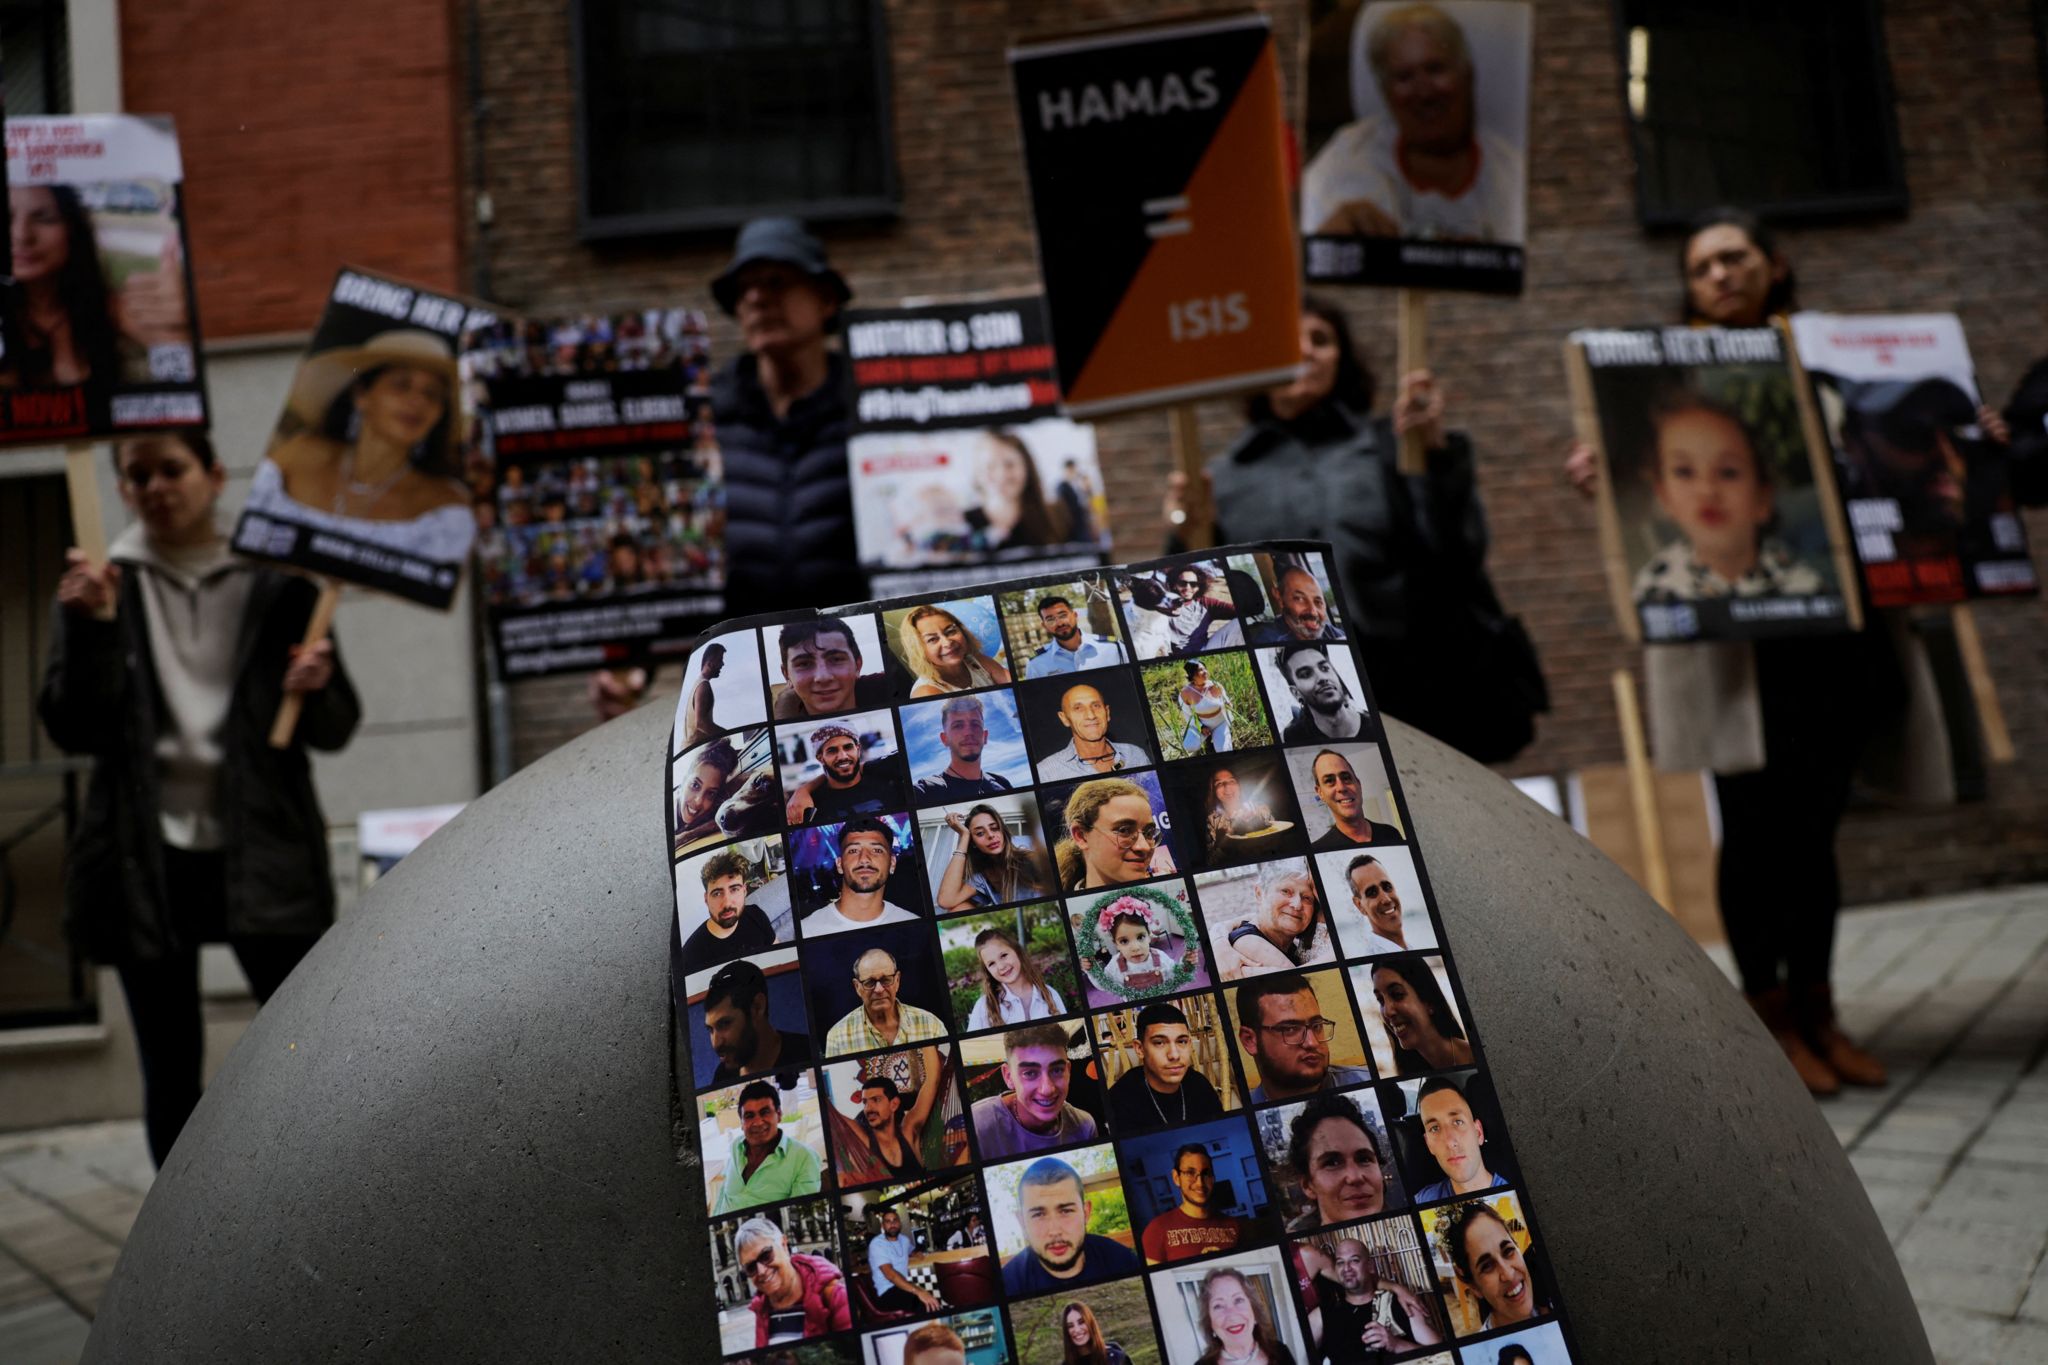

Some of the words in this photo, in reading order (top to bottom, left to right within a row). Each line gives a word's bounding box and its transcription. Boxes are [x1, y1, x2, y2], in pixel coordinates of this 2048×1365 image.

[1038, 67, 1220, 131] HAMAS
[849, 319, 948, 358] MOTHER
[968, 311, 1024, 349] SON
[1168, 292, 1251, 342] ISIS
